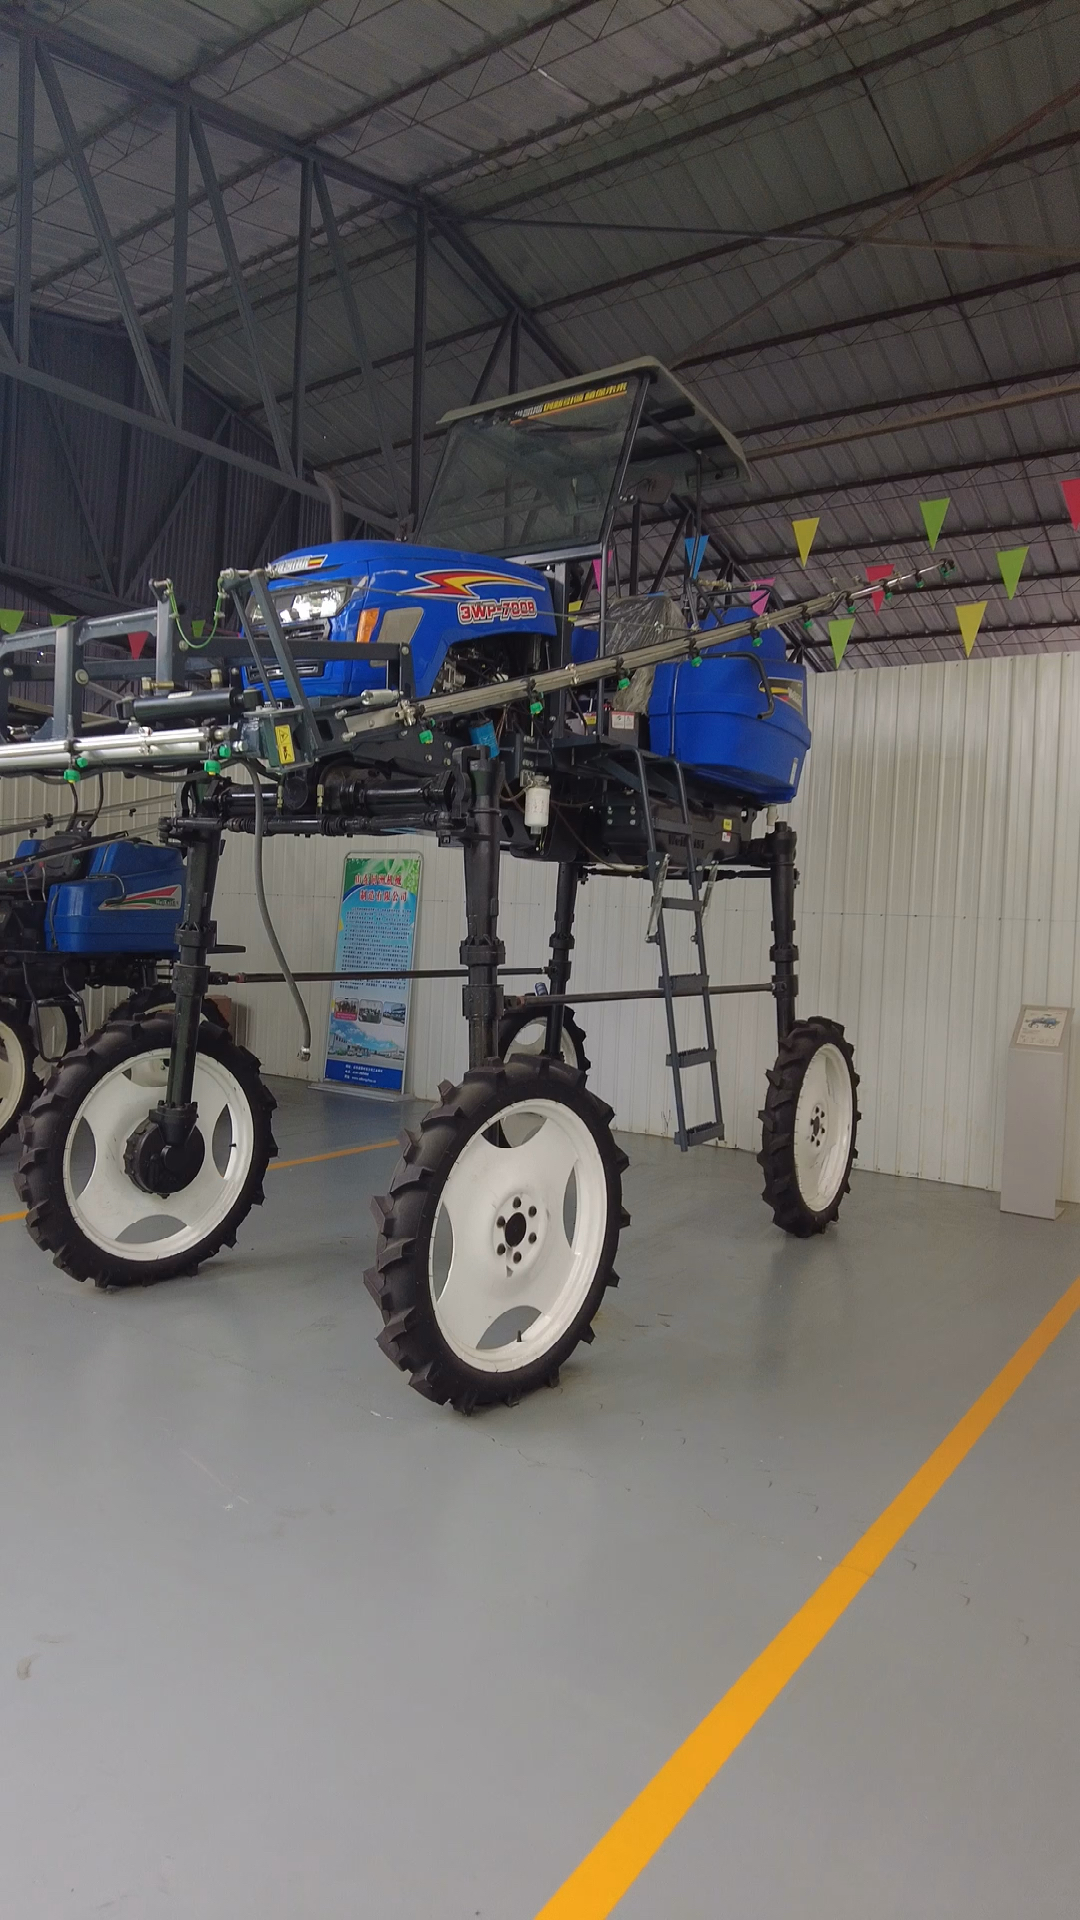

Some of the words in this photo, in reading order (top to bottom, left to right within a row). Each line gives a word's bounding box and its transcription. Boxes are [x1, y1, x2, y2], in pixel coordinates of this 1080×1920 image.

[359, 889, 407, 902] 制造有限公司
